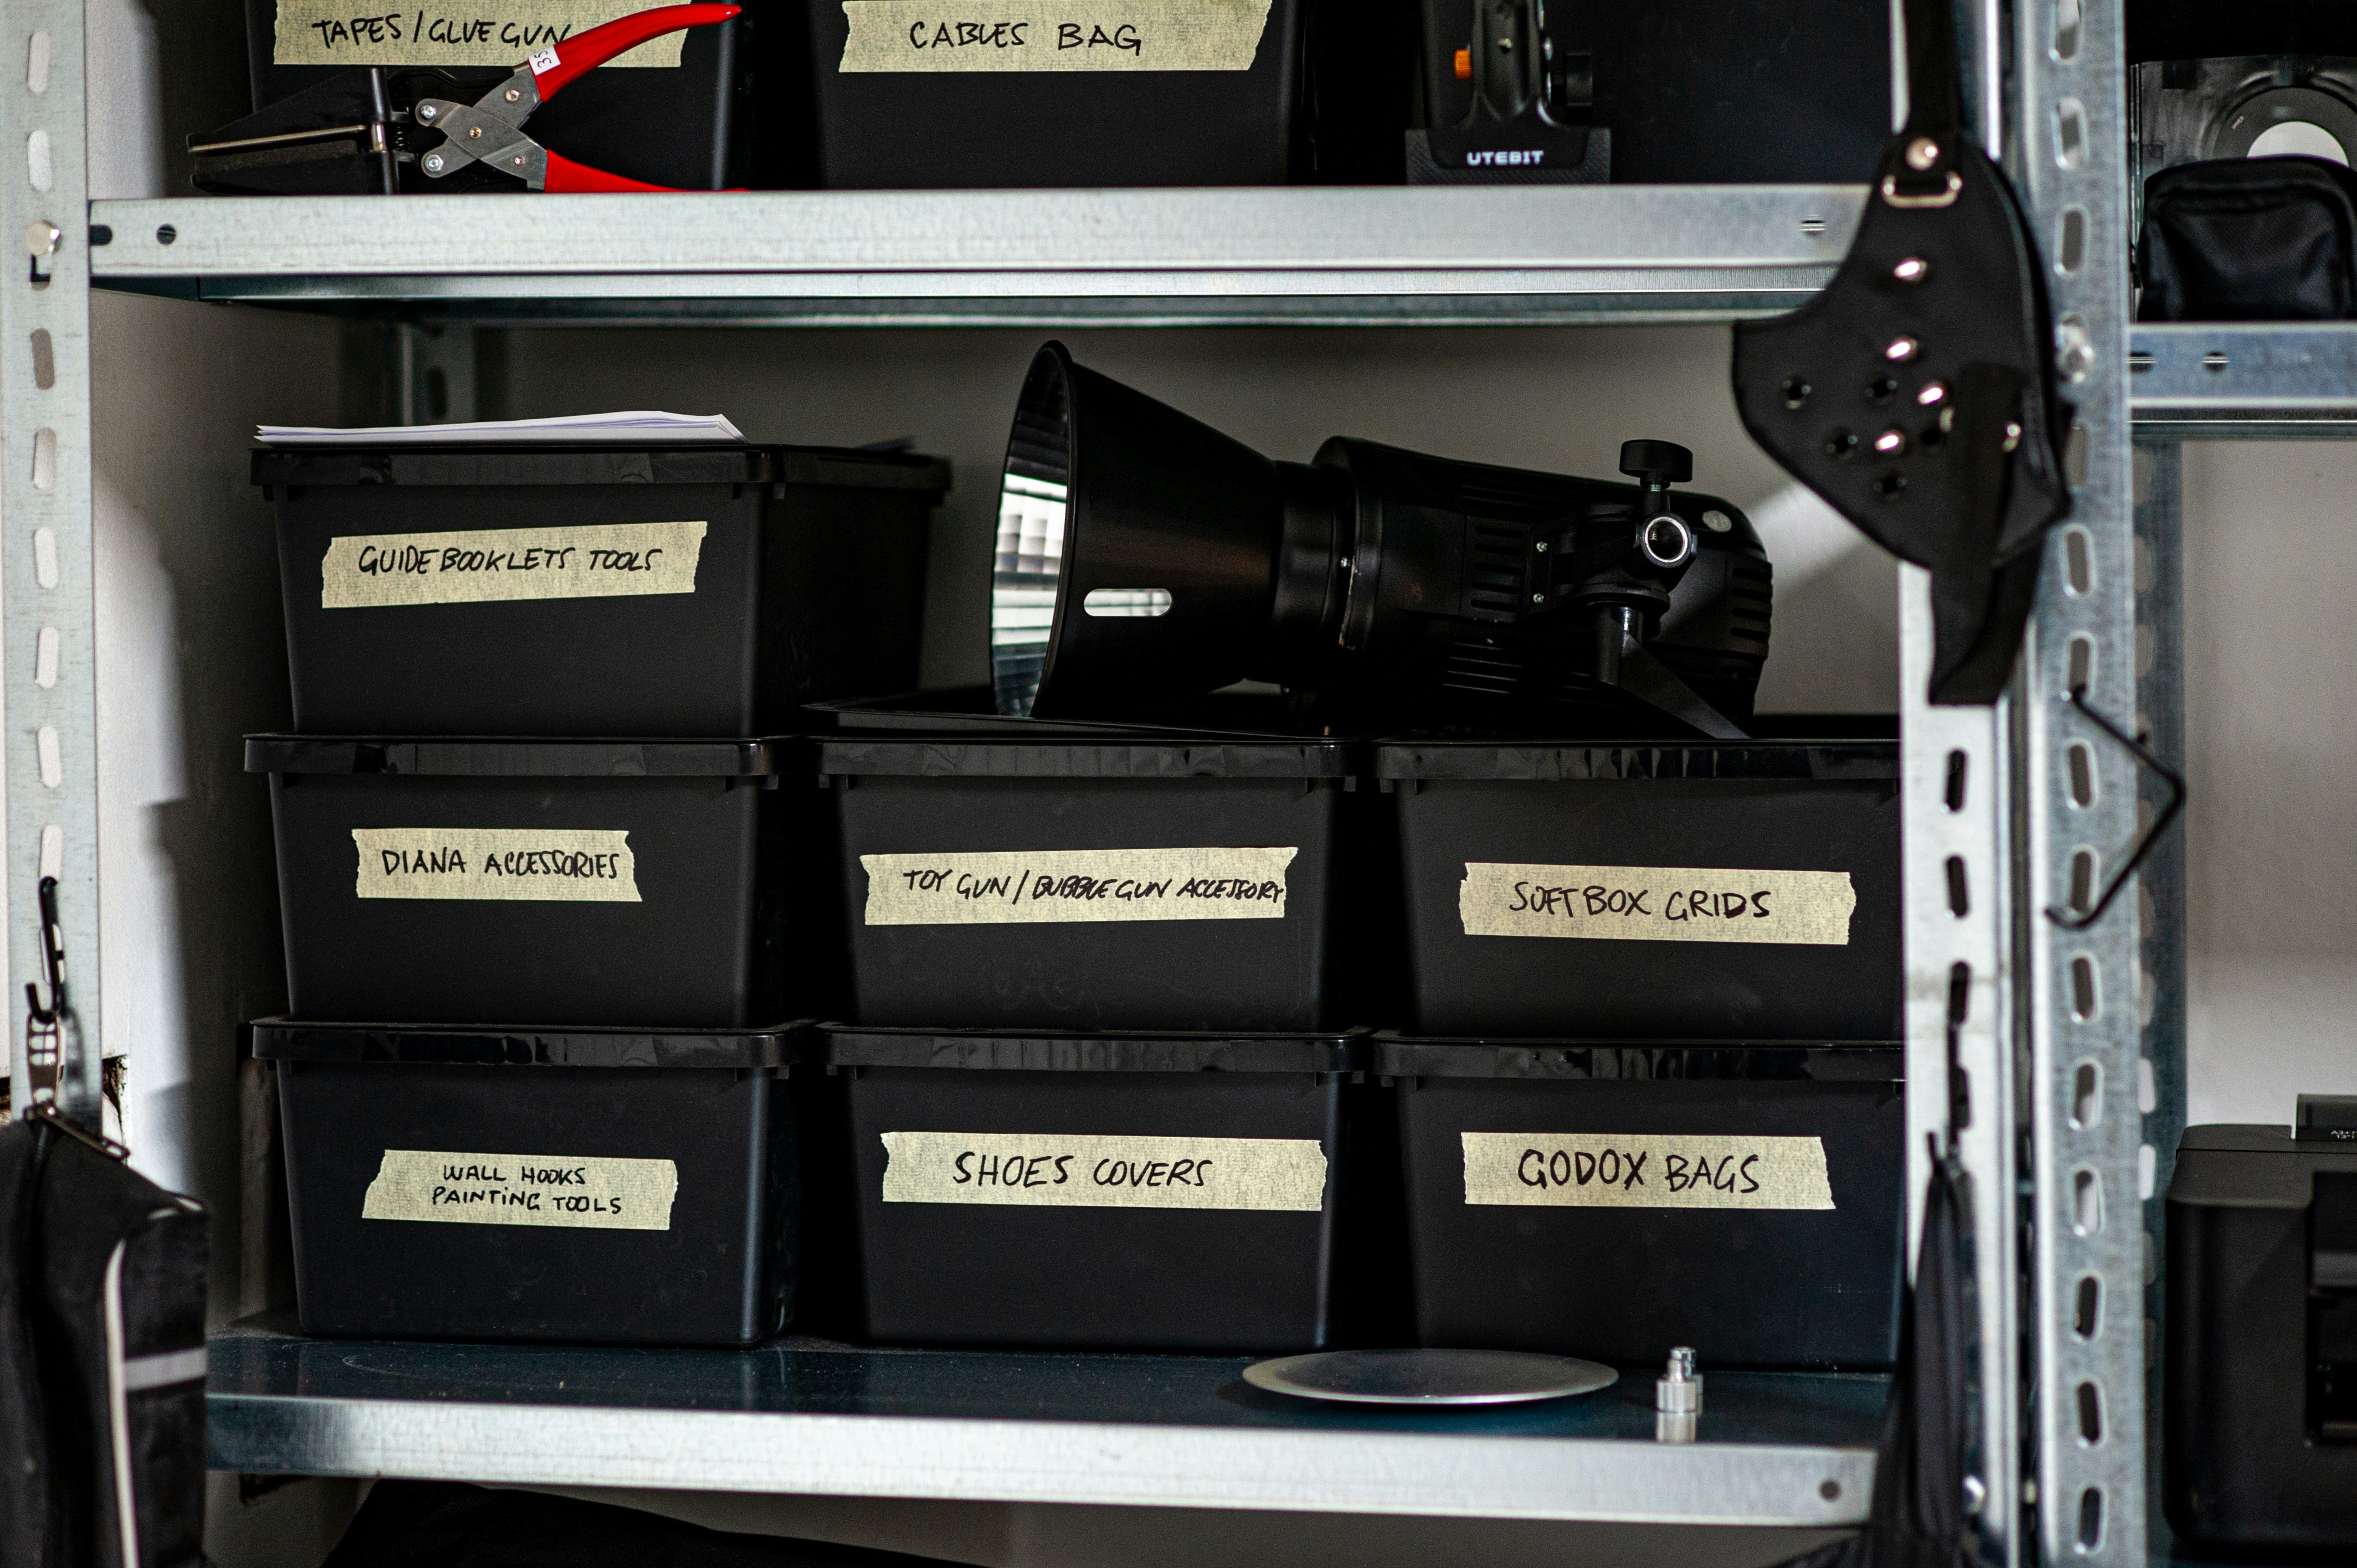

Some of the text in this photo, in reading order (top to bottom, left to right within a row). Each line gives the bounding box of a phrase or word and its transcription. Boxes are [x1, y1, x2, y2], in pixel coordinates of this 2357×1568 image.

[311, 13, 402, 49] TAPES
[501, 22, 572, 48] GUN
[910, 21, 1142, 56] CABLES BAG
[1466, 150, 1544, 166] UTEBIT
[589, 548, 662, 571] TOOLS
[382, 847, 620, 879] DIANA ACCESSORIES
[903, 869, 953, 892] TOY
[1665, 890, 1771, 921] GRIDS
[443, 1165, 586, 1185] WALL HOOKS
[953, 1151, 1213, 1188] SHOES COVERS
[1518, 1148, 1759, 1194] GODOX BAGS
[552, 1196, 622, 1215] TOOLS
